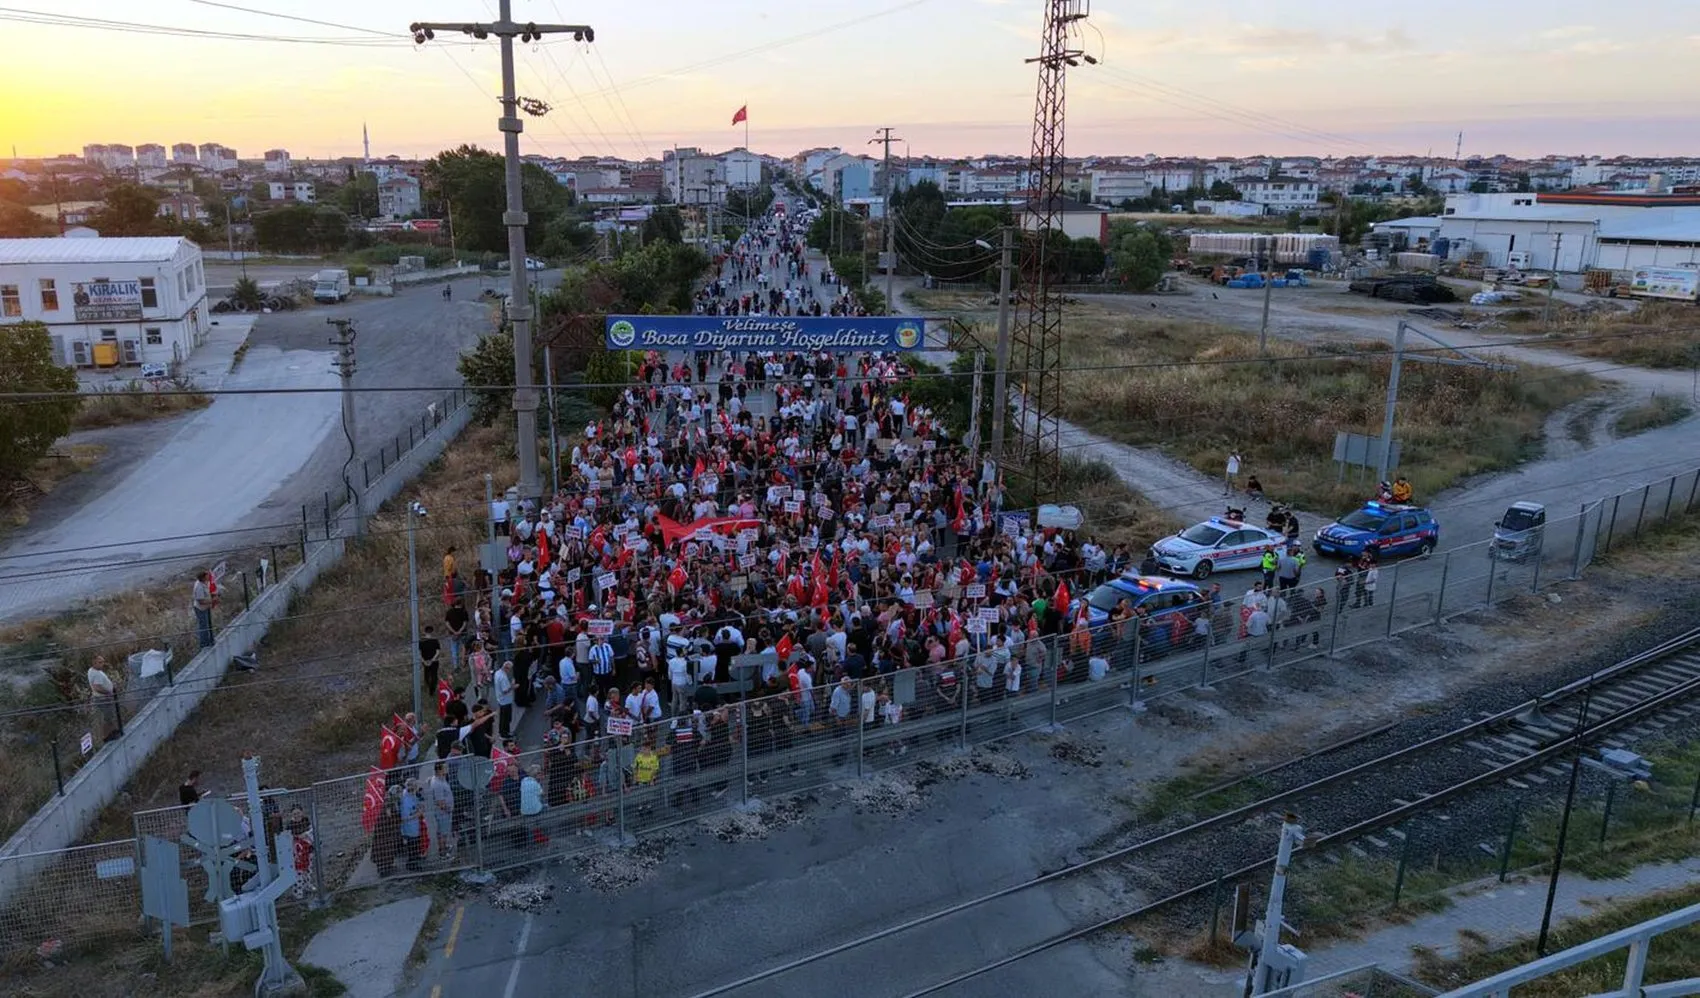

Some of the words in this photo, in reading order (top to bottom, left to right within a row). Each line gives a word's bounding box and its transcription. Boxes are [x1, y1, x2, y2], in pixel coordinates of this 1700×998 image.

[723, 318, 796, 332] Velimeşe
[642, 330, 689, 345] Boza
[694, 330, 777, 350] Diyarına
[780, 328, 889, 350] Hoşgeldiniz
